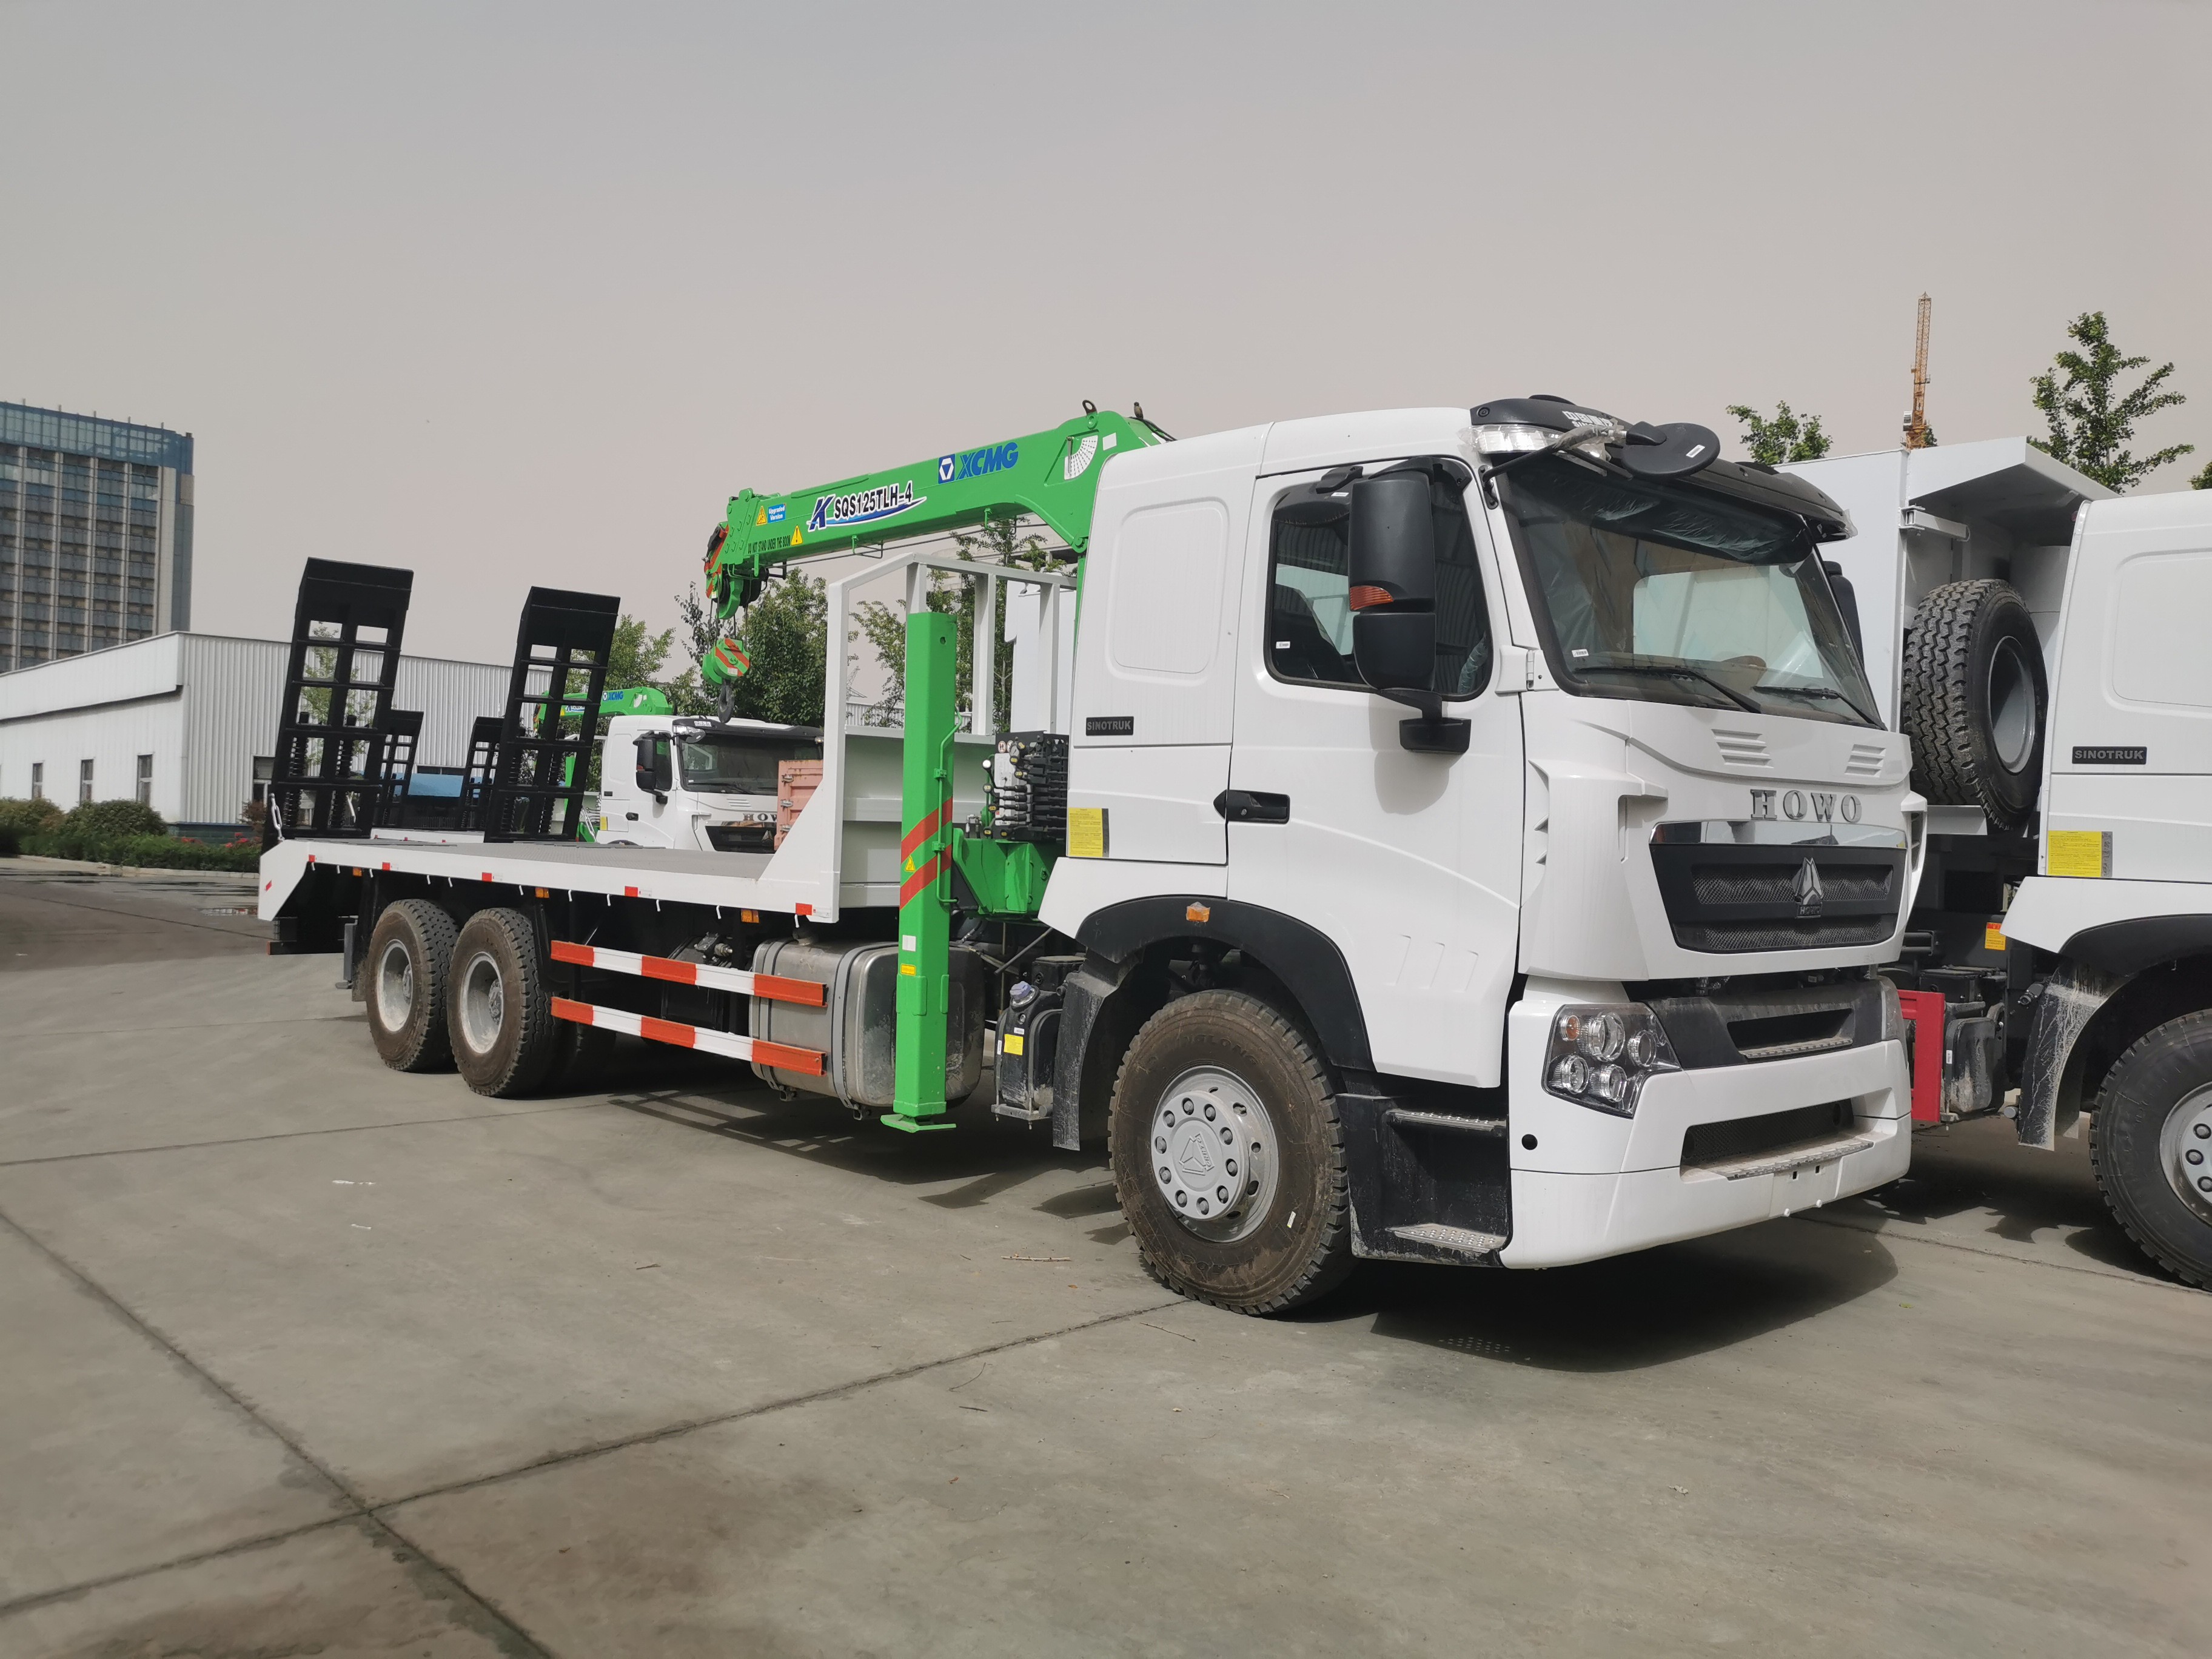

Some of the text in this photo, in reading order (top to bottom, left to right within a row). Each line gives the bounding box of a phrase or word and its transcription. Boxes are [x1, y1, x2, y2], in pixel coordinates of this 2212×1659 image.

[956, 442, 1019, 480] XCMG
[834, 482, 912, 519] SQS125TLH-4
[769, 505, 785, 514] Upgraded
[748, 543, 751, 554] DO
[767, 538, 776, 550] UNDER
[1087, 720, 1131, 731] SINOTRUK
[2074, 750, 2144, 759] SINOTRUK
[1750, 788, 1863, 823] HOWO
[743, 813, 777, 822] HOW
